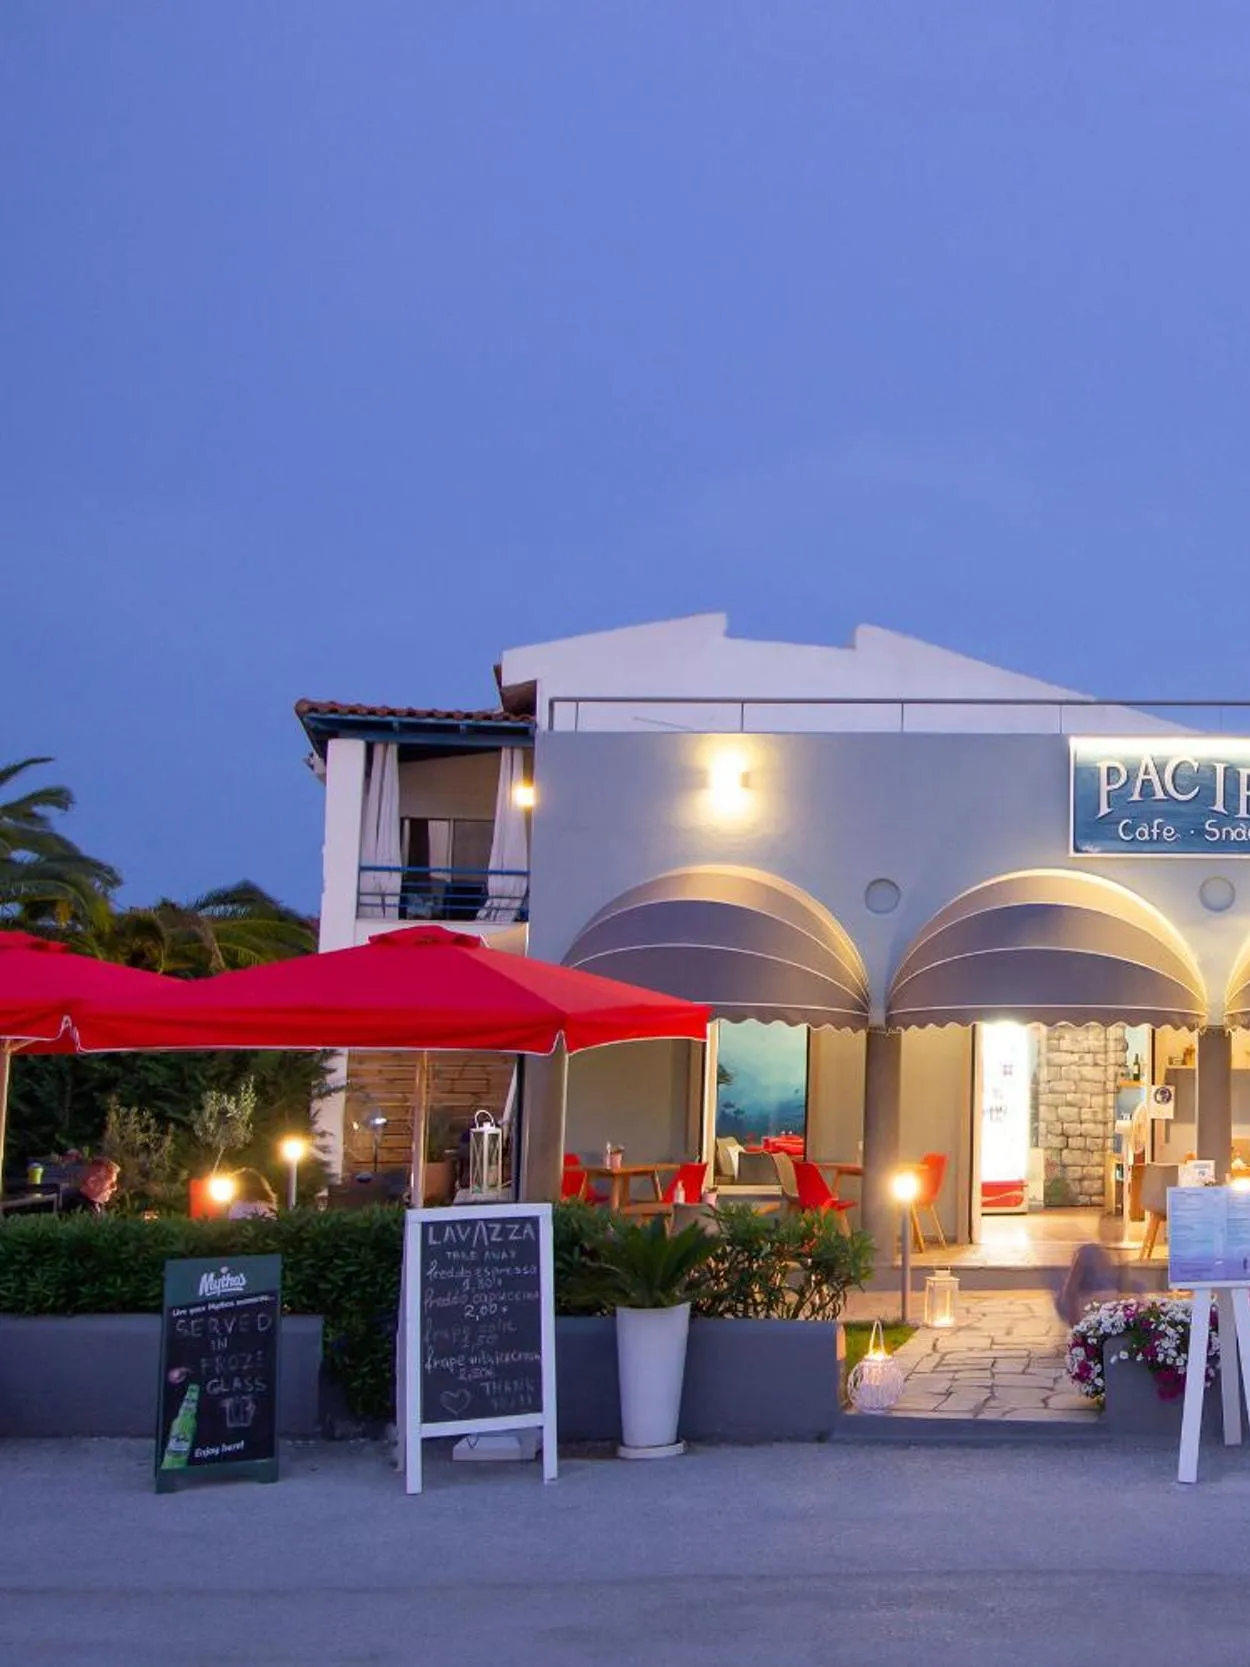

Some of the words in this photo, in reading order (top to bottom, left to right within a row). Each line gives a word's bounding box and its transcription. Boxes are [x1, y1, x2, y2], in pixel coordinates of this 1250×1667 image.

[1118, 817, 1180, 842] Cafe
[428, 1220, 536, 1247] LAVAZZA
[445, 1250, 479, 1261] TAKE
[484, 1248, 517, 1261] AWAY
[199, 1271, 247, 1296] Mythos
[175, 1313, 273, 1338] SERVED
[210, 1337, 228, 1352] IN
[206, 1376, 268, 1395] GLASS
